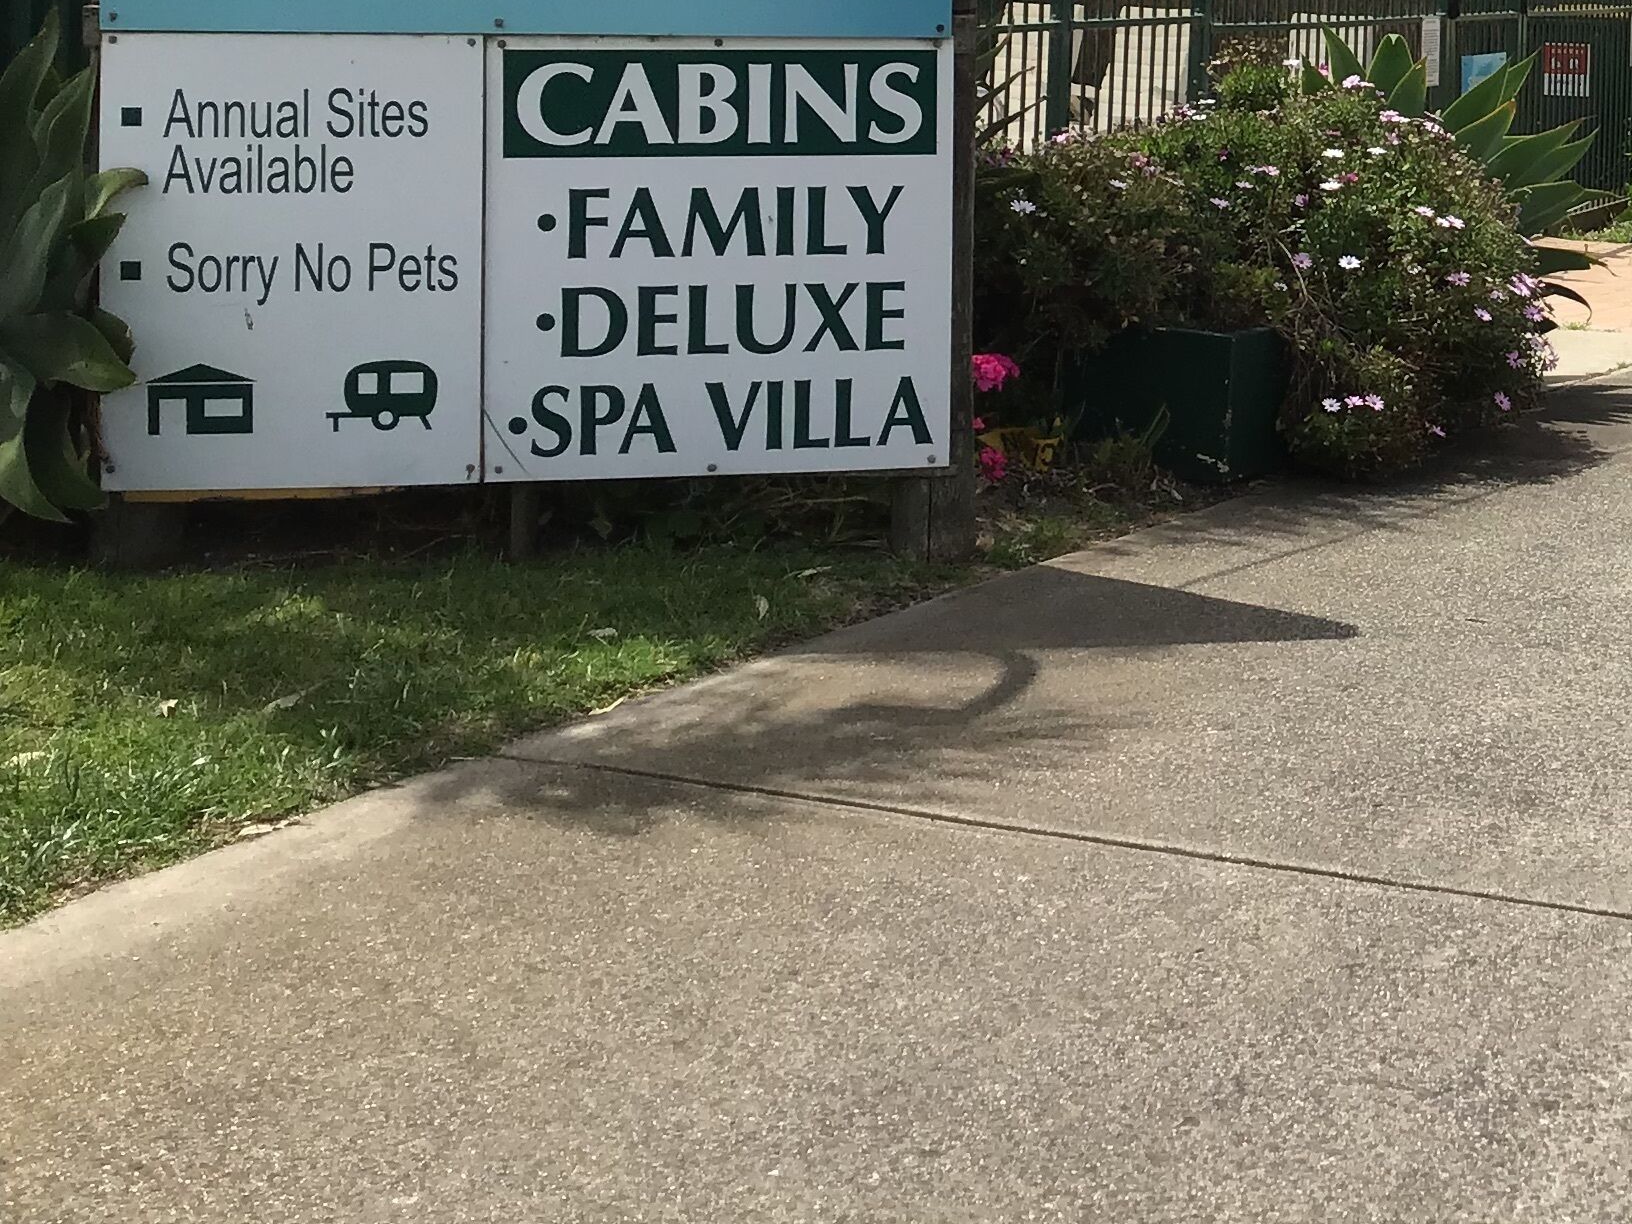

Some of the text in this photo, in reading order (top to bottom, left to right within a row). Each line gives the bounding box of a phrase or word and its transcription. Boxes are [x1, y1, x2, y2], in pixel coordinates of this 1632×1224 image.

[163, 88, 428, 138] Annual Sites
[517, 63, 922, 145] CABINS
[162, 144, 353, 194] Available
[568, 186, 904, 258] FAMILY
[167, 242, 458, 306] Sorry No Pets
[561, 281, 905, 357] DELUXE
[531, 376, 933, 457] SPA VILLA
